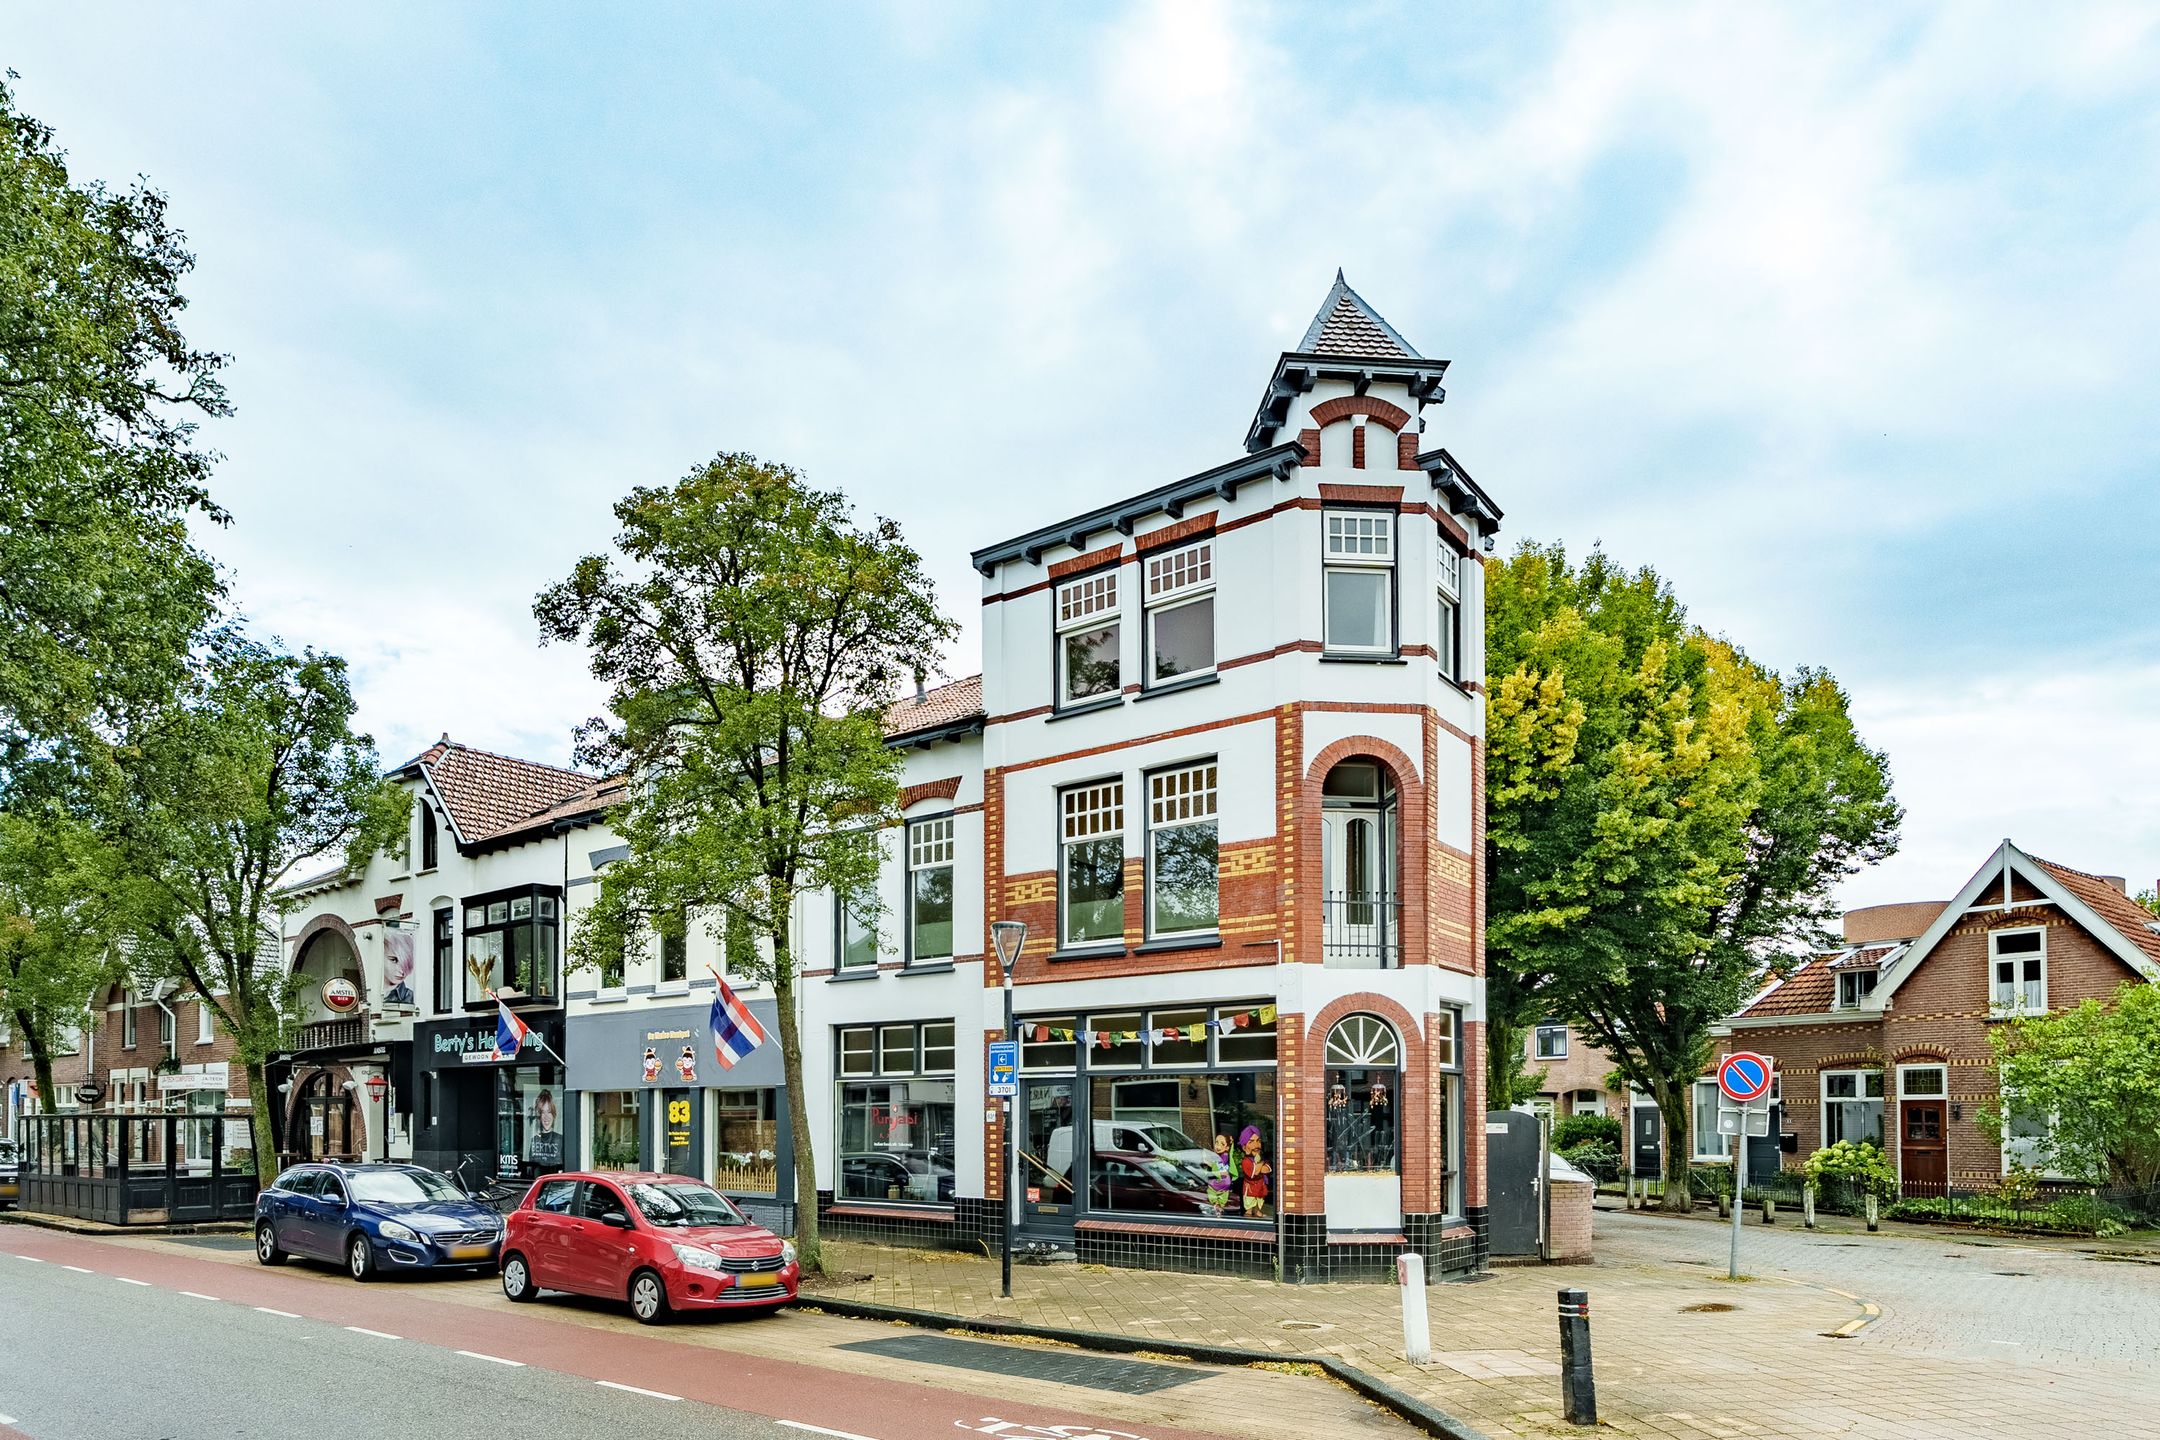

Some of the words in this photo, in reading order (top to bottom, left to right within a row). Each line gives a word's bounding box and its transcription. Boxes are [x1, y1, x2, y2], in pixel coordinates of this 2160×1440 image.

[434, 1031, 474, 1056] Berty's
[669, 1100, 690, 1123] 83
[872, 1105, 918, 1132] Punjabi
